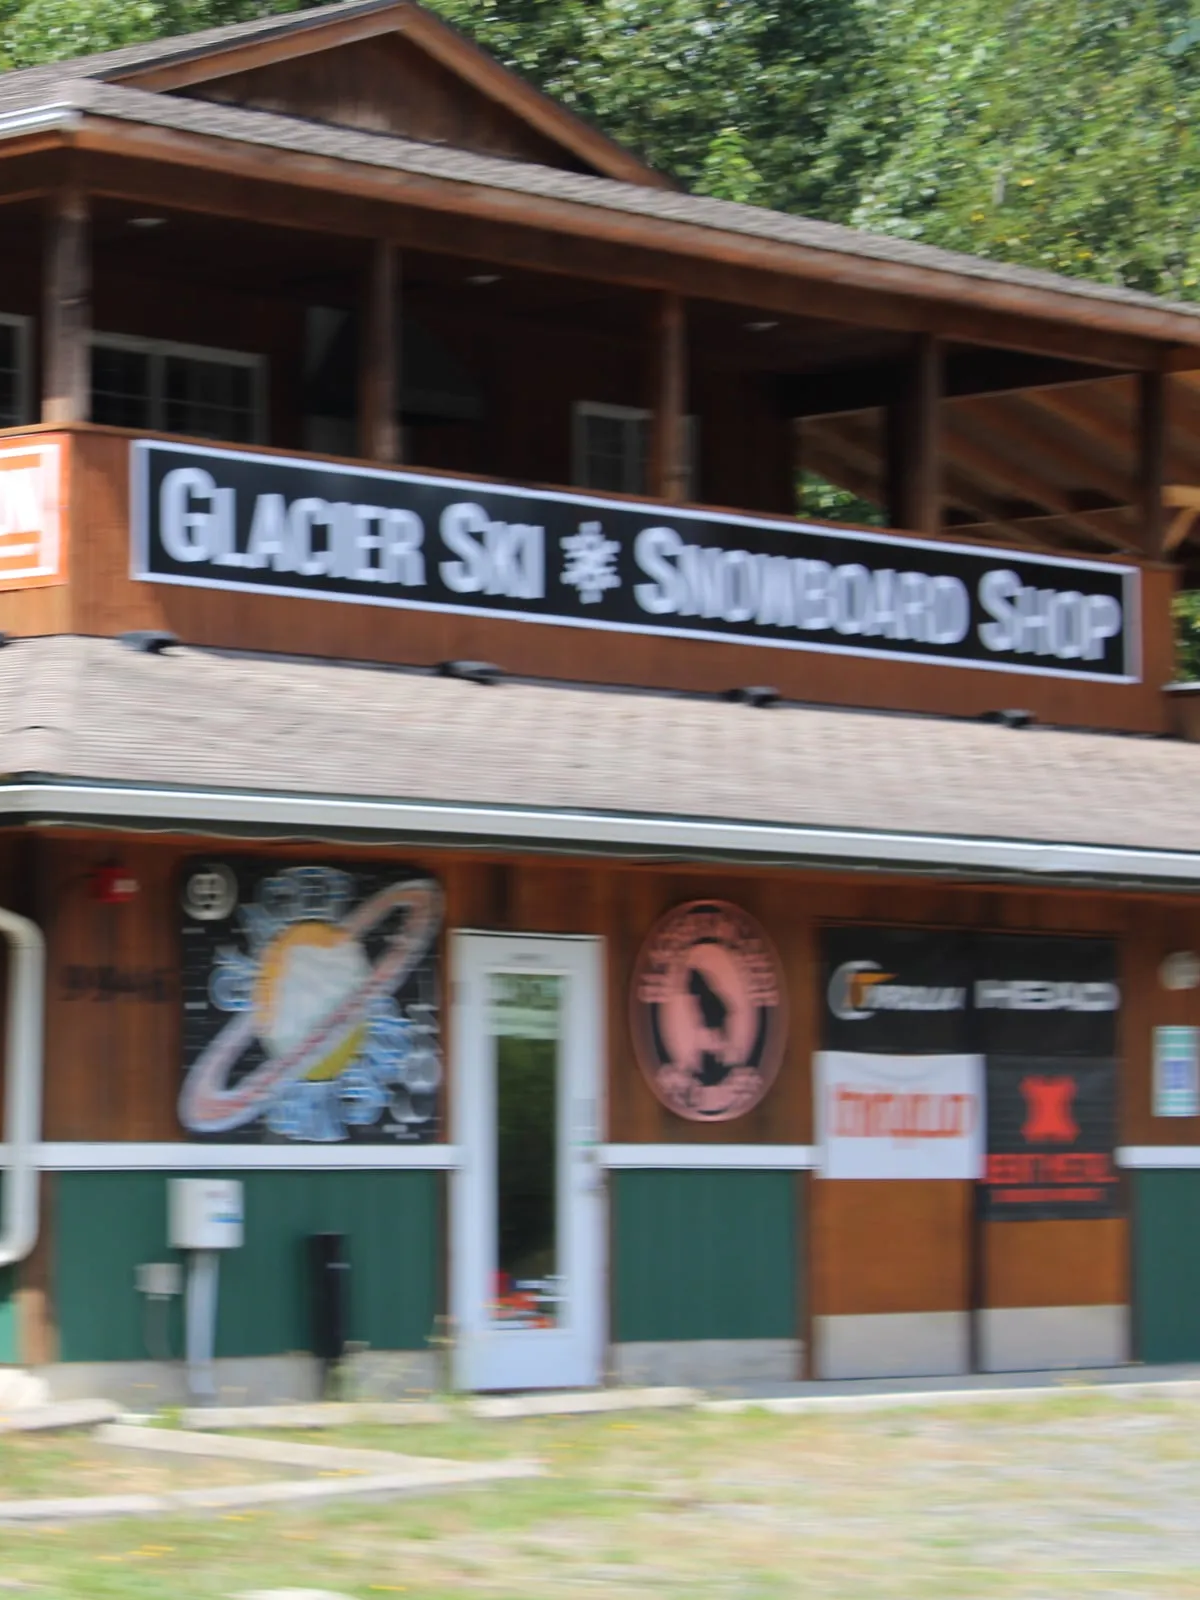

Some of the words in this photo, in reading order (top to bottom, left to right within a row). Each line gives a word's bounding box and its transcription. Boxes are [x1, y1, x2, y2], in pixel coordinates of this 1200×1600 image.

[158, 467, 426, 586] GLACIER
[438, 502, 546, 600] SKI
[633, 526, 967, 646] SNOWBOARD
[978, 568, 1122, 661] SHOP
